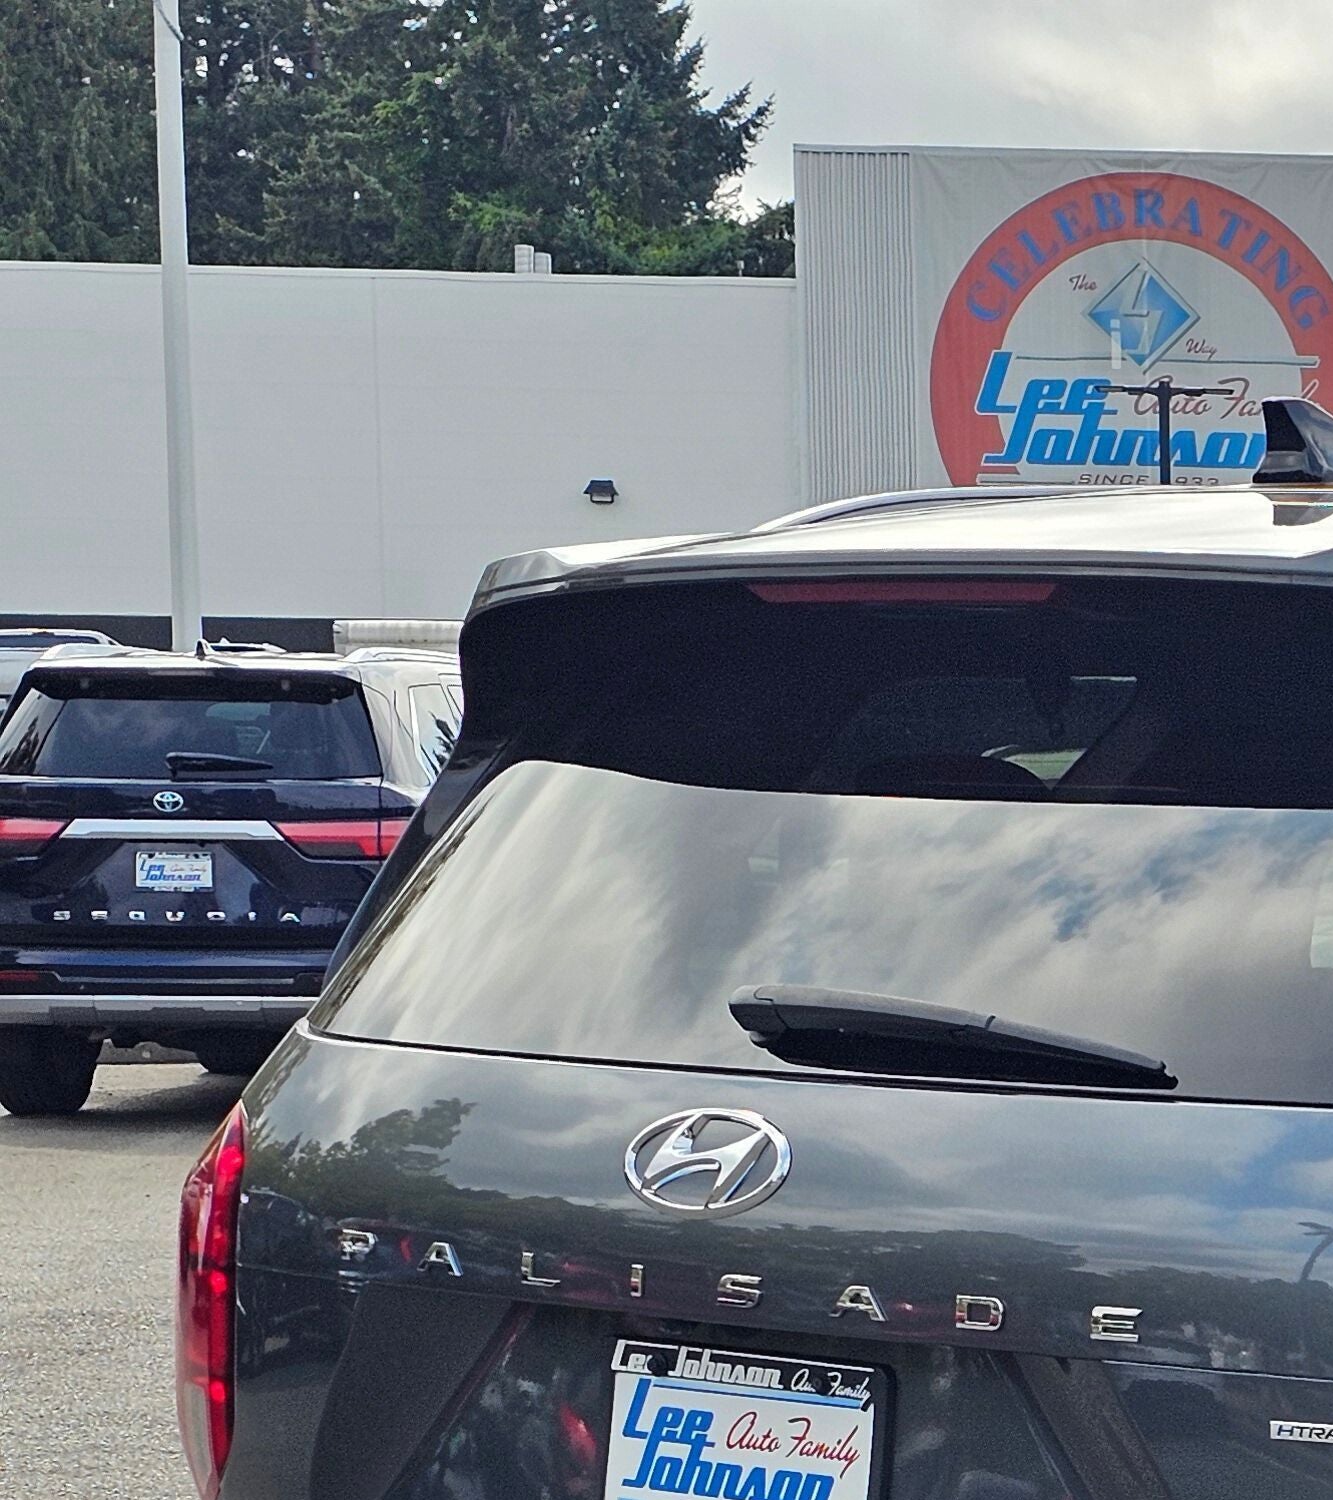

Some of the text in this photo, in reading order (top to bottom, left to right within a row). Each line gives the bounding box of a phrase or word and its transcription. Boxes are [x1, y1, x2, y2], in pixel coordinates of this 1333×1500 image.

[965, 187, 1330, 331] CELEBRATING
[1069, 274, 1098, 291] The
[1185, 338, 1218, 360] Way
[976, 350, 1120, 415] Lee
[1078, 473, 1151, 485] SINCE
[52, 909, 301, 923] SEQUOIA
[338, 1227, 1144, 1344] PALISADE
[667, 1345, 785, 1389] Johnson
[827, 1371, 872, 1401] Family
[621, 1377, 861, 1479] Lee Auto Family
